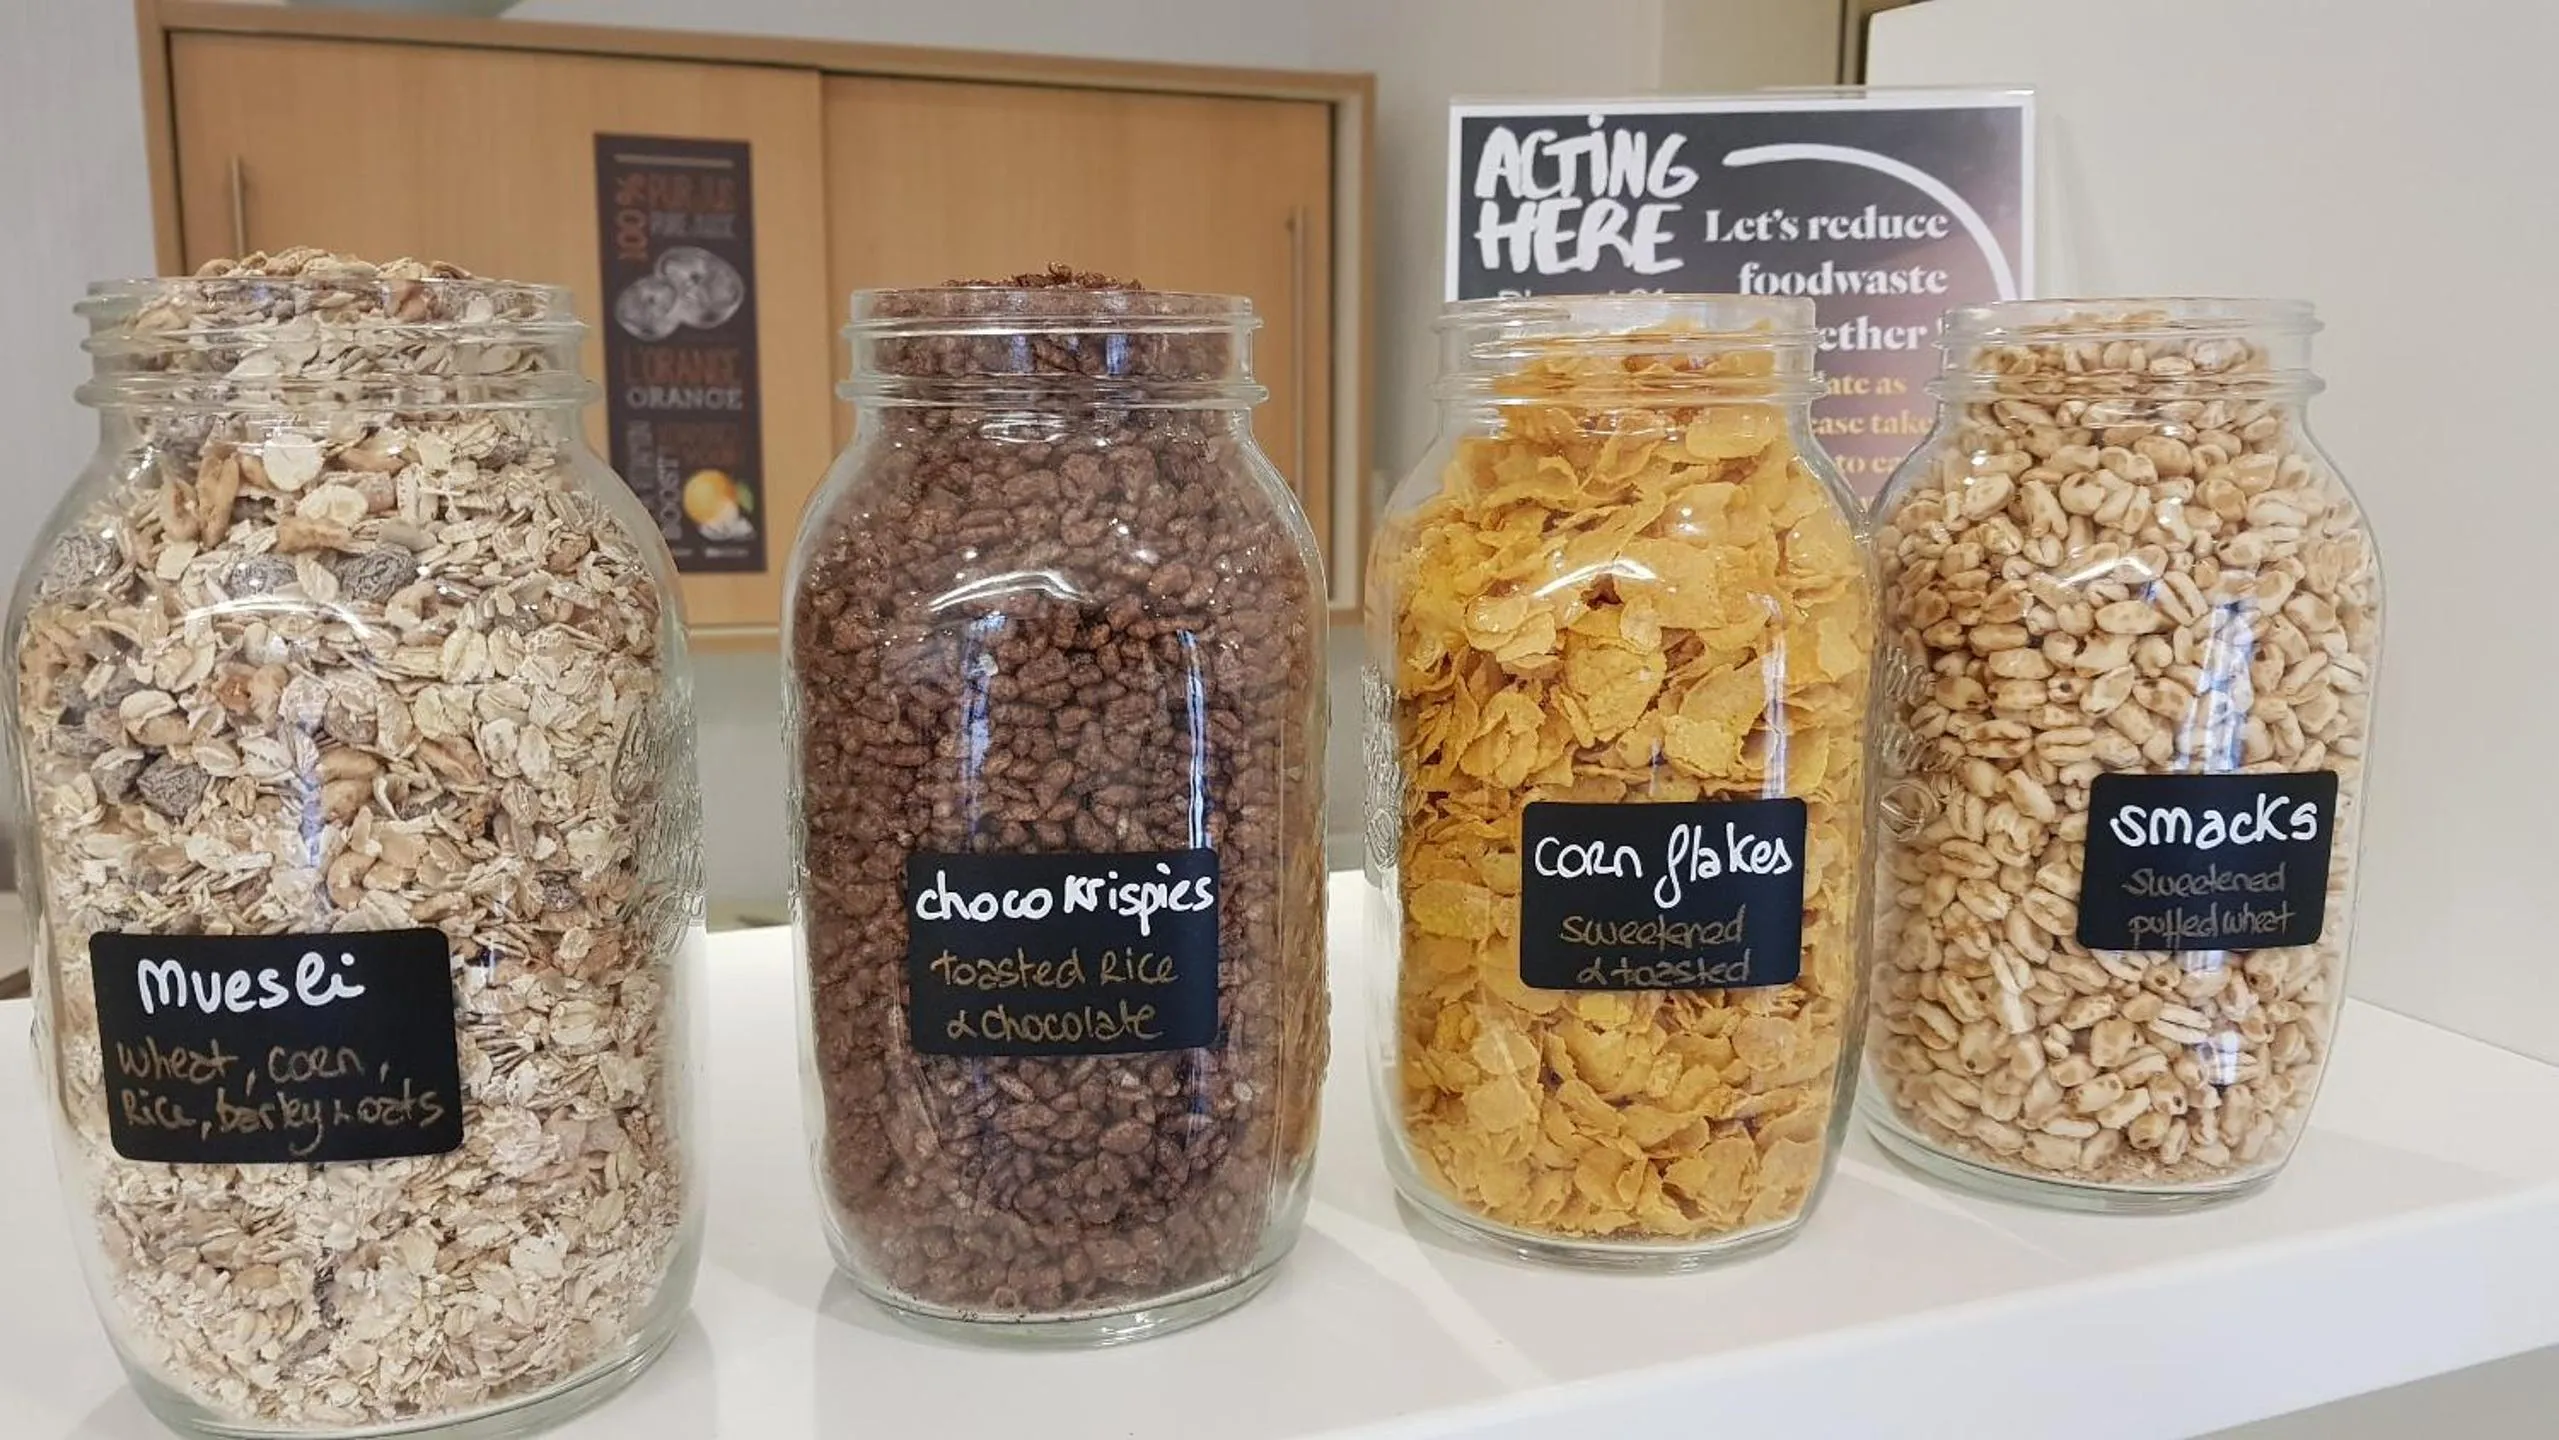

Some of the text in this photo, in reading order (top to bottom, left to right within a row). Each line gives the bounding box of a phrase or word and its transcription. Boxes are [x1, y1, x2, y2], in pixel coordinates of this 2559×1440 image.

[1474, 199, 1684, 275] HERE
[1704, 204, 1949, 242] Let's reduce
[1737, 260, 1949, 296] foodwaste
[1818, 315, 1928, 350] ether
[626, 385, 744, 411] ORANGE
[1826, 374, 1908, 395] ate as
[1653, 822, 1794, 908] flakes
[915, 869, 1054, 922] choco
[2128, 900, 2297, 950] puffed wheat
[137, 951, 366, 1015] Muesli
[930, 946, 1180, 990] toasted Rice
[1610, 949, 1751, 987] toasted
[980, 999, 1165, 1043] chocolate
[356, 1077, 445, 1128] oats
